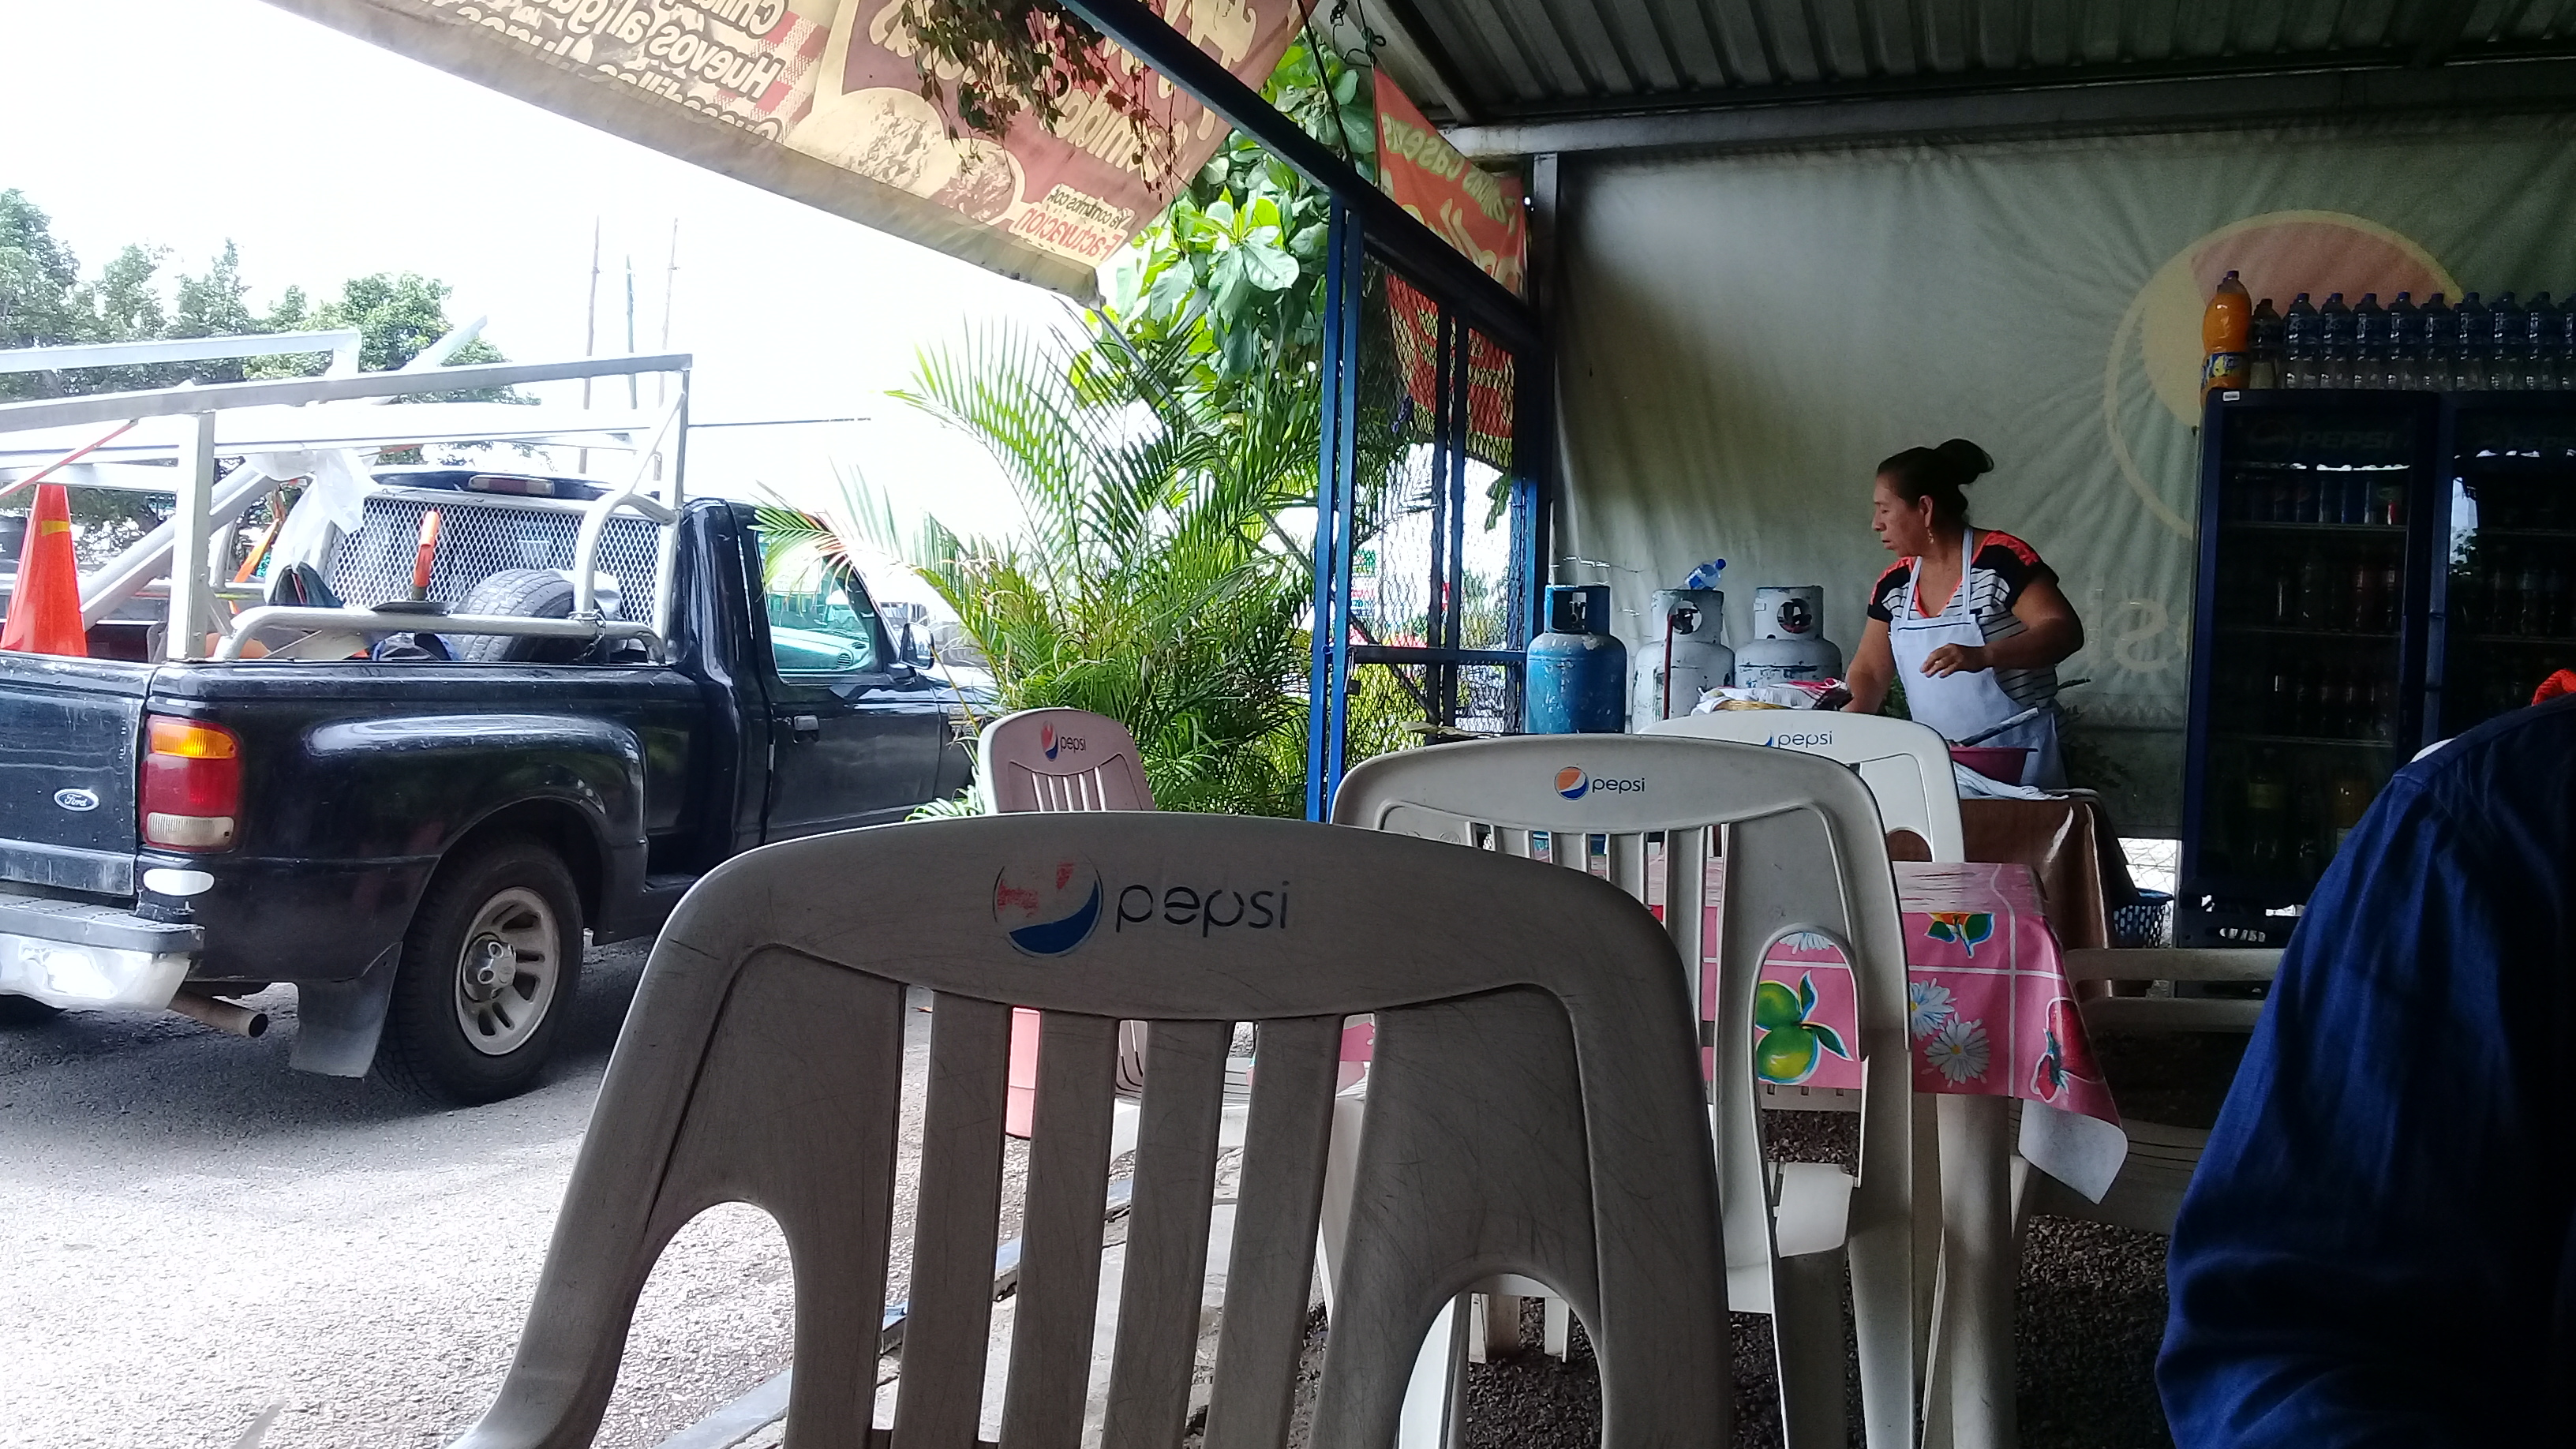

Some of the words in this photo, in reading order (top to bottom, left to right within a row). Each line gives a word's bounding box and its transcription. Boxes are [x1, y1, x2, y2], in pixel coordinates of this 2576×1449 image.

[1060, 735, 1087, 754] pepsi
[1778, 730, 1833, 749] pepsi
[1592, 777, 1646, 795] pepsi
[1115, 880, 1290, 938] pepsi
